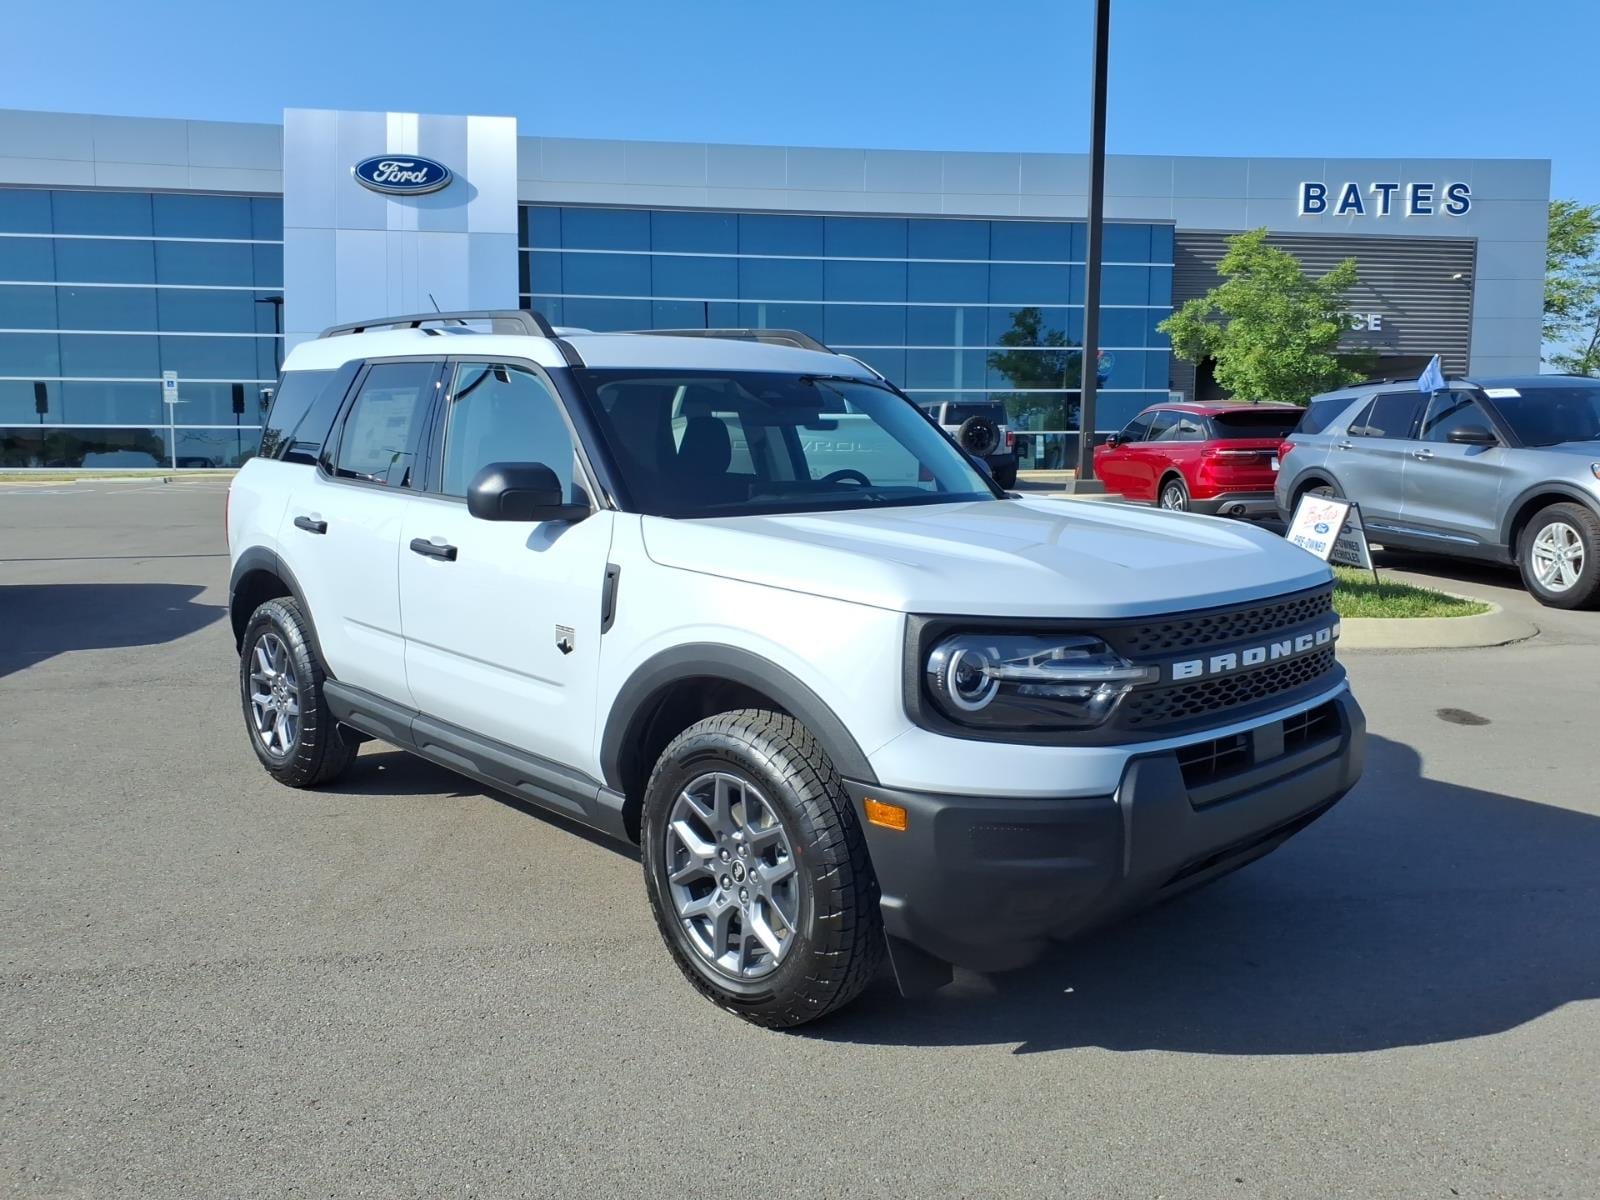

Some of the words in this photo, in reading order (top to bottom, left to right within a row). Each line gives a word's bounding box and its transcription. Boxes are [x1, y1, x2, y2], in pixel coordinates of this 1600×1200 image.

[373, 161, 428, 183] Ford
[1299, 182, 1472, 217] BATES
[1294, 534, 1327, 553] PRE-OWNED
[1172, 627, 1331, 681] BRONCO
